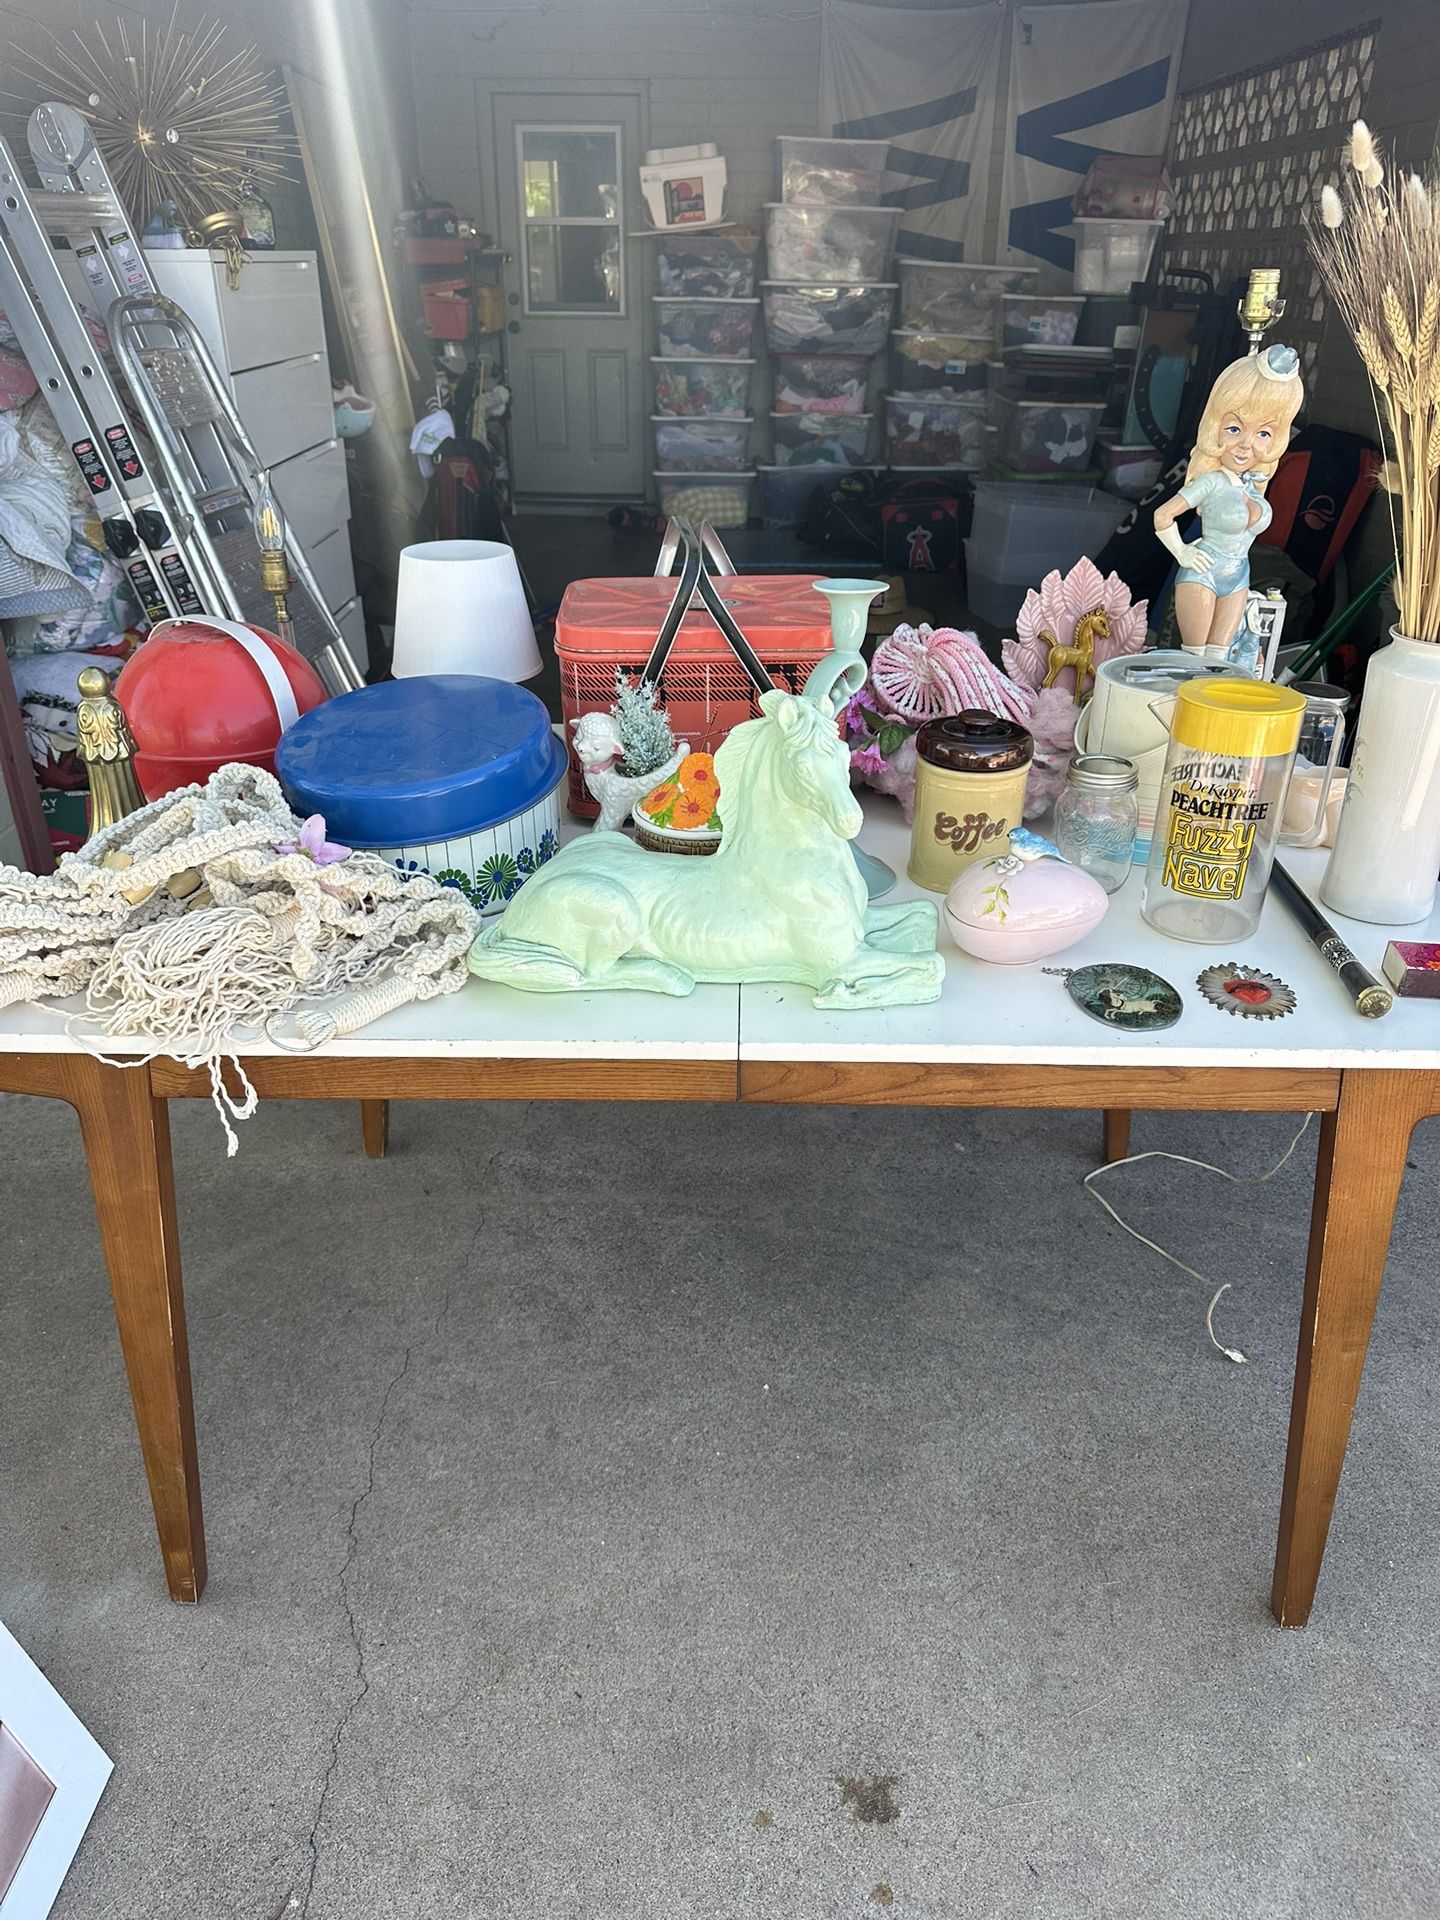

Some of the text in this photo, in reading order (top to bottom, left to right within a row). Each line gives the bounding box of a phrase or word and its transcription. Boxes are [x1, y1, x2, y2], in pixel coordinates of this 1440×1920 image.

[1170, 790, 1269, 820] PEACHTREE
[934, 811, 1008, 855] Coffee
[1169, 812, 1256, 859] Fuzzy
[1162, 847, 1248, 900] Navel
